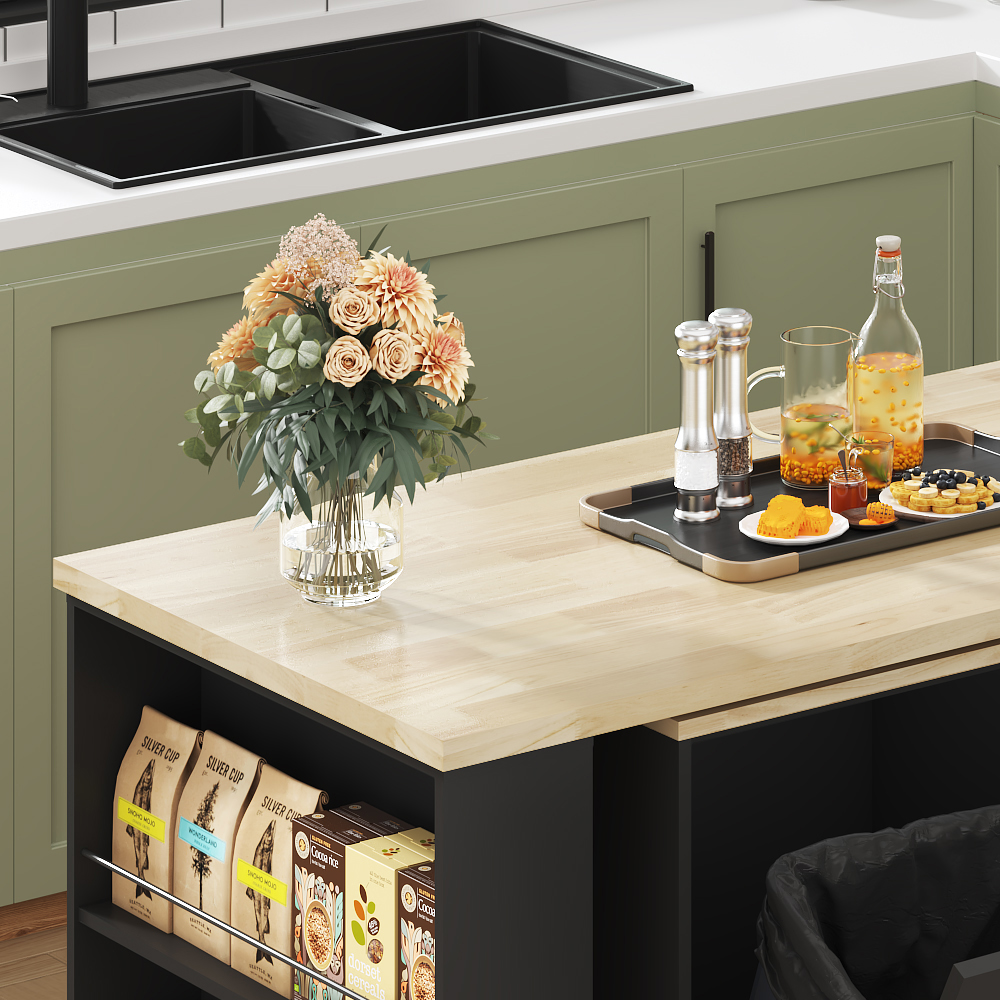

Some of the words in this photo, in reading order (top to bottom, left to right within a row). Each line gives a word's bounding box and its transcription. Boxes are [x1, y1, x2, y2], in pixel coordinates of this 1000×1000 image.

[142, 736, 166, 757] SILVER
[164, 748, 180, 763] CUP
[206, 755, 230, 778] SILVER
[229, 768, 245, 784] CUP
[262, 796, 286, 817] SILVER
[128, 808, 142, 820] SNOHO
[144, 816, 155, 827] MOJO
[189, 827, 217, 848] WONDERLAND
[312, 846, 328, 863] Cocoa
[329, 854, 338, 868] rice
[248, 870, 263, 883] SNOHO
[264, 879, 277, 890] MOJO
[419, 899, 435, 917] Cocoa
[348, 953, 381, 981] dorset
